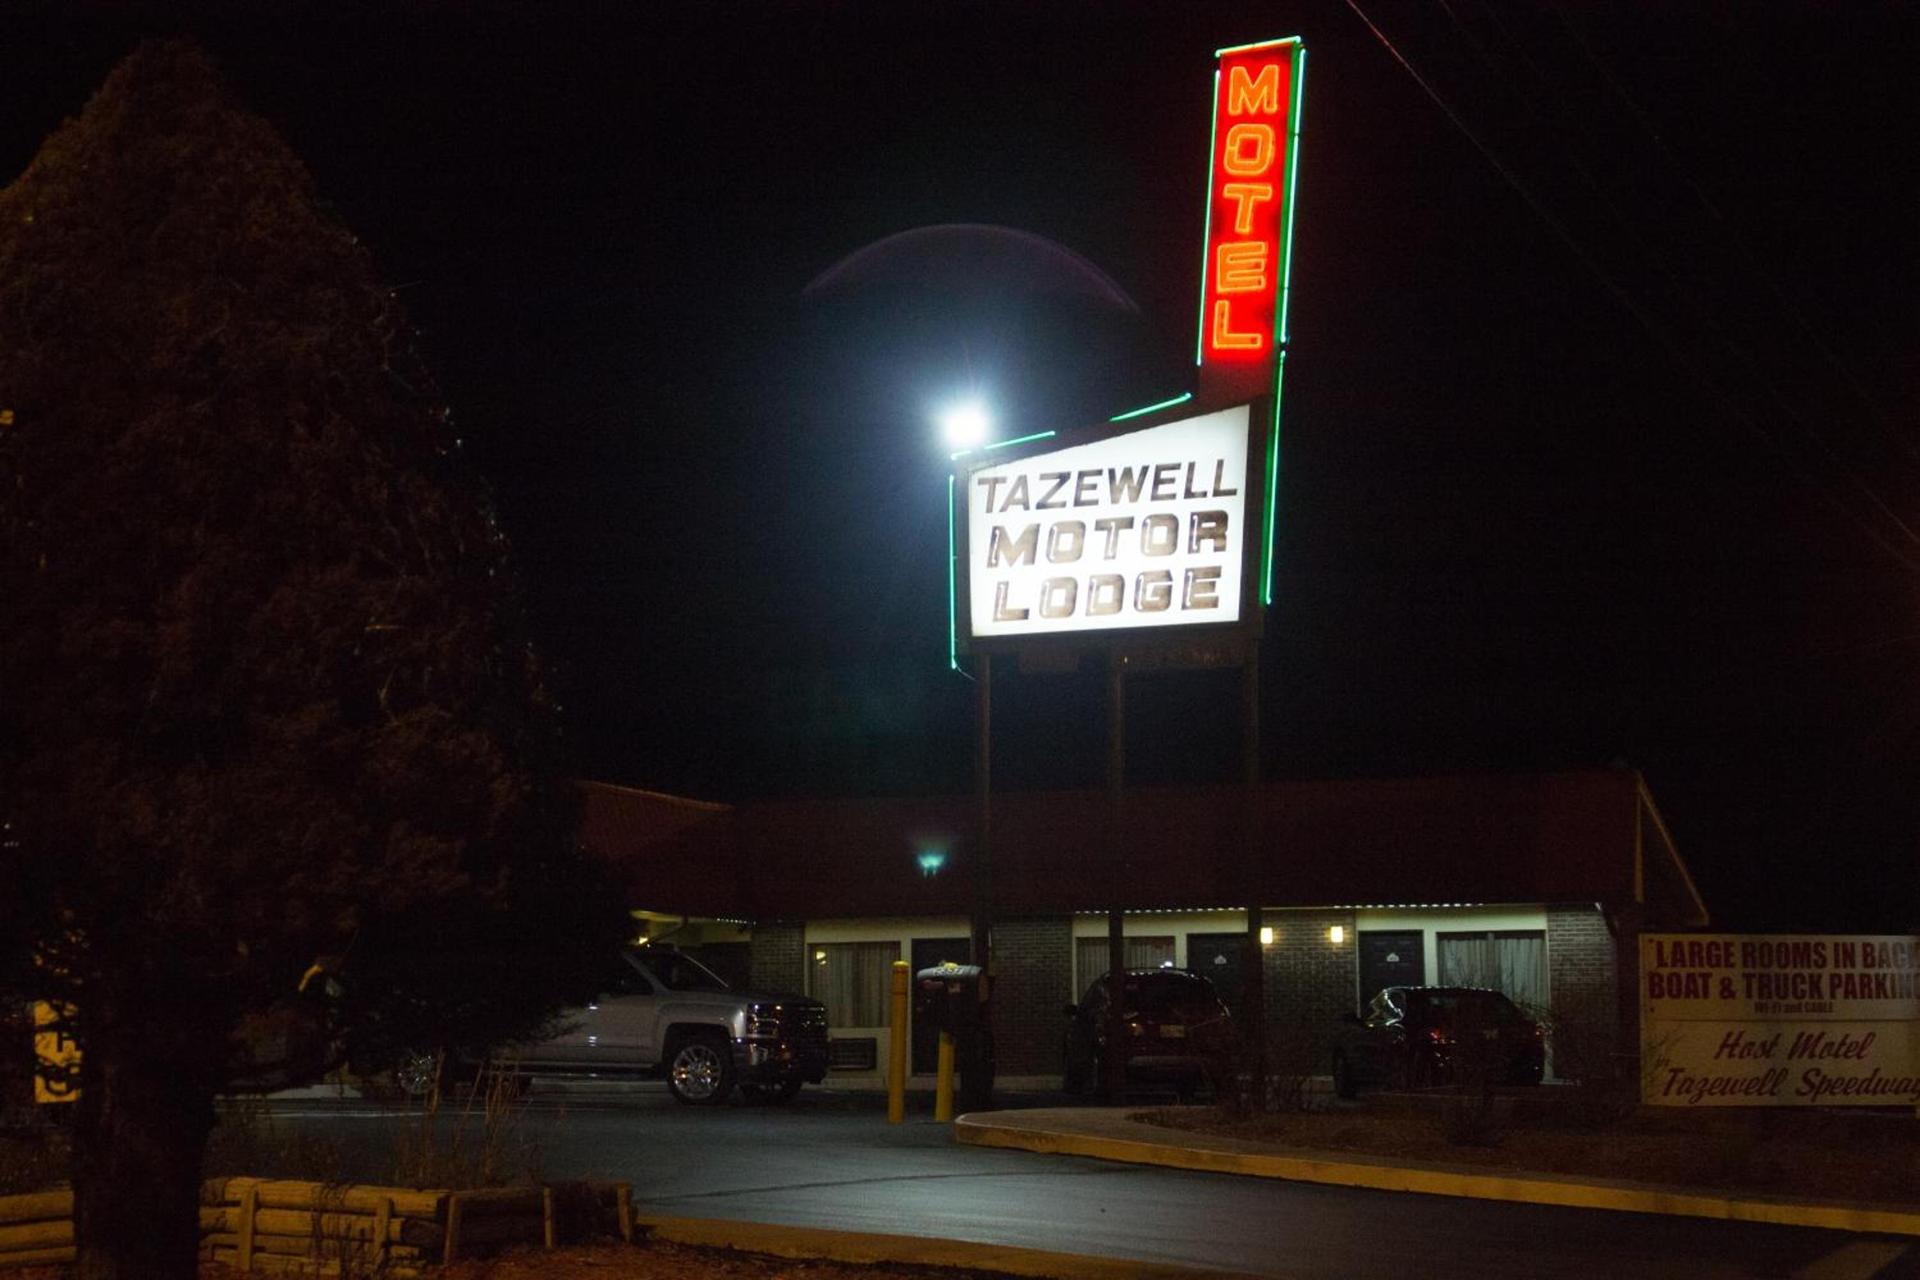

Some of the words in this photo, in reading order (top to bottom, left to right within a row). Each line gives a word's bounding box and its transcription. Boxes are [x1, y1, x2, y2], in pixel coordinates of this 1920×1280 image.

[1213, 64, 1280, 349] MOTEL
[977, 459, 1238, 514] TAZEWELL
[986, 510, 1229, 568] MOTOR
[993, 565, 1222, 622] LODGE
[1656, 941, 1734, 968] LARGE
[1742, 942, 1827, 969] ROOMS
[1834, 942, 1855, 968] IN
[1649, 972, 1713, 999] BOAT
[1720, 977, 1736, 999] &
[1742, 973, 1823, 999] TRUCK
[1714, 1031, 1781, 1060] Host
[1787, 1032, 1876, 1060] Motel
[1663, 1068, 1789, 1104] Tazewell
